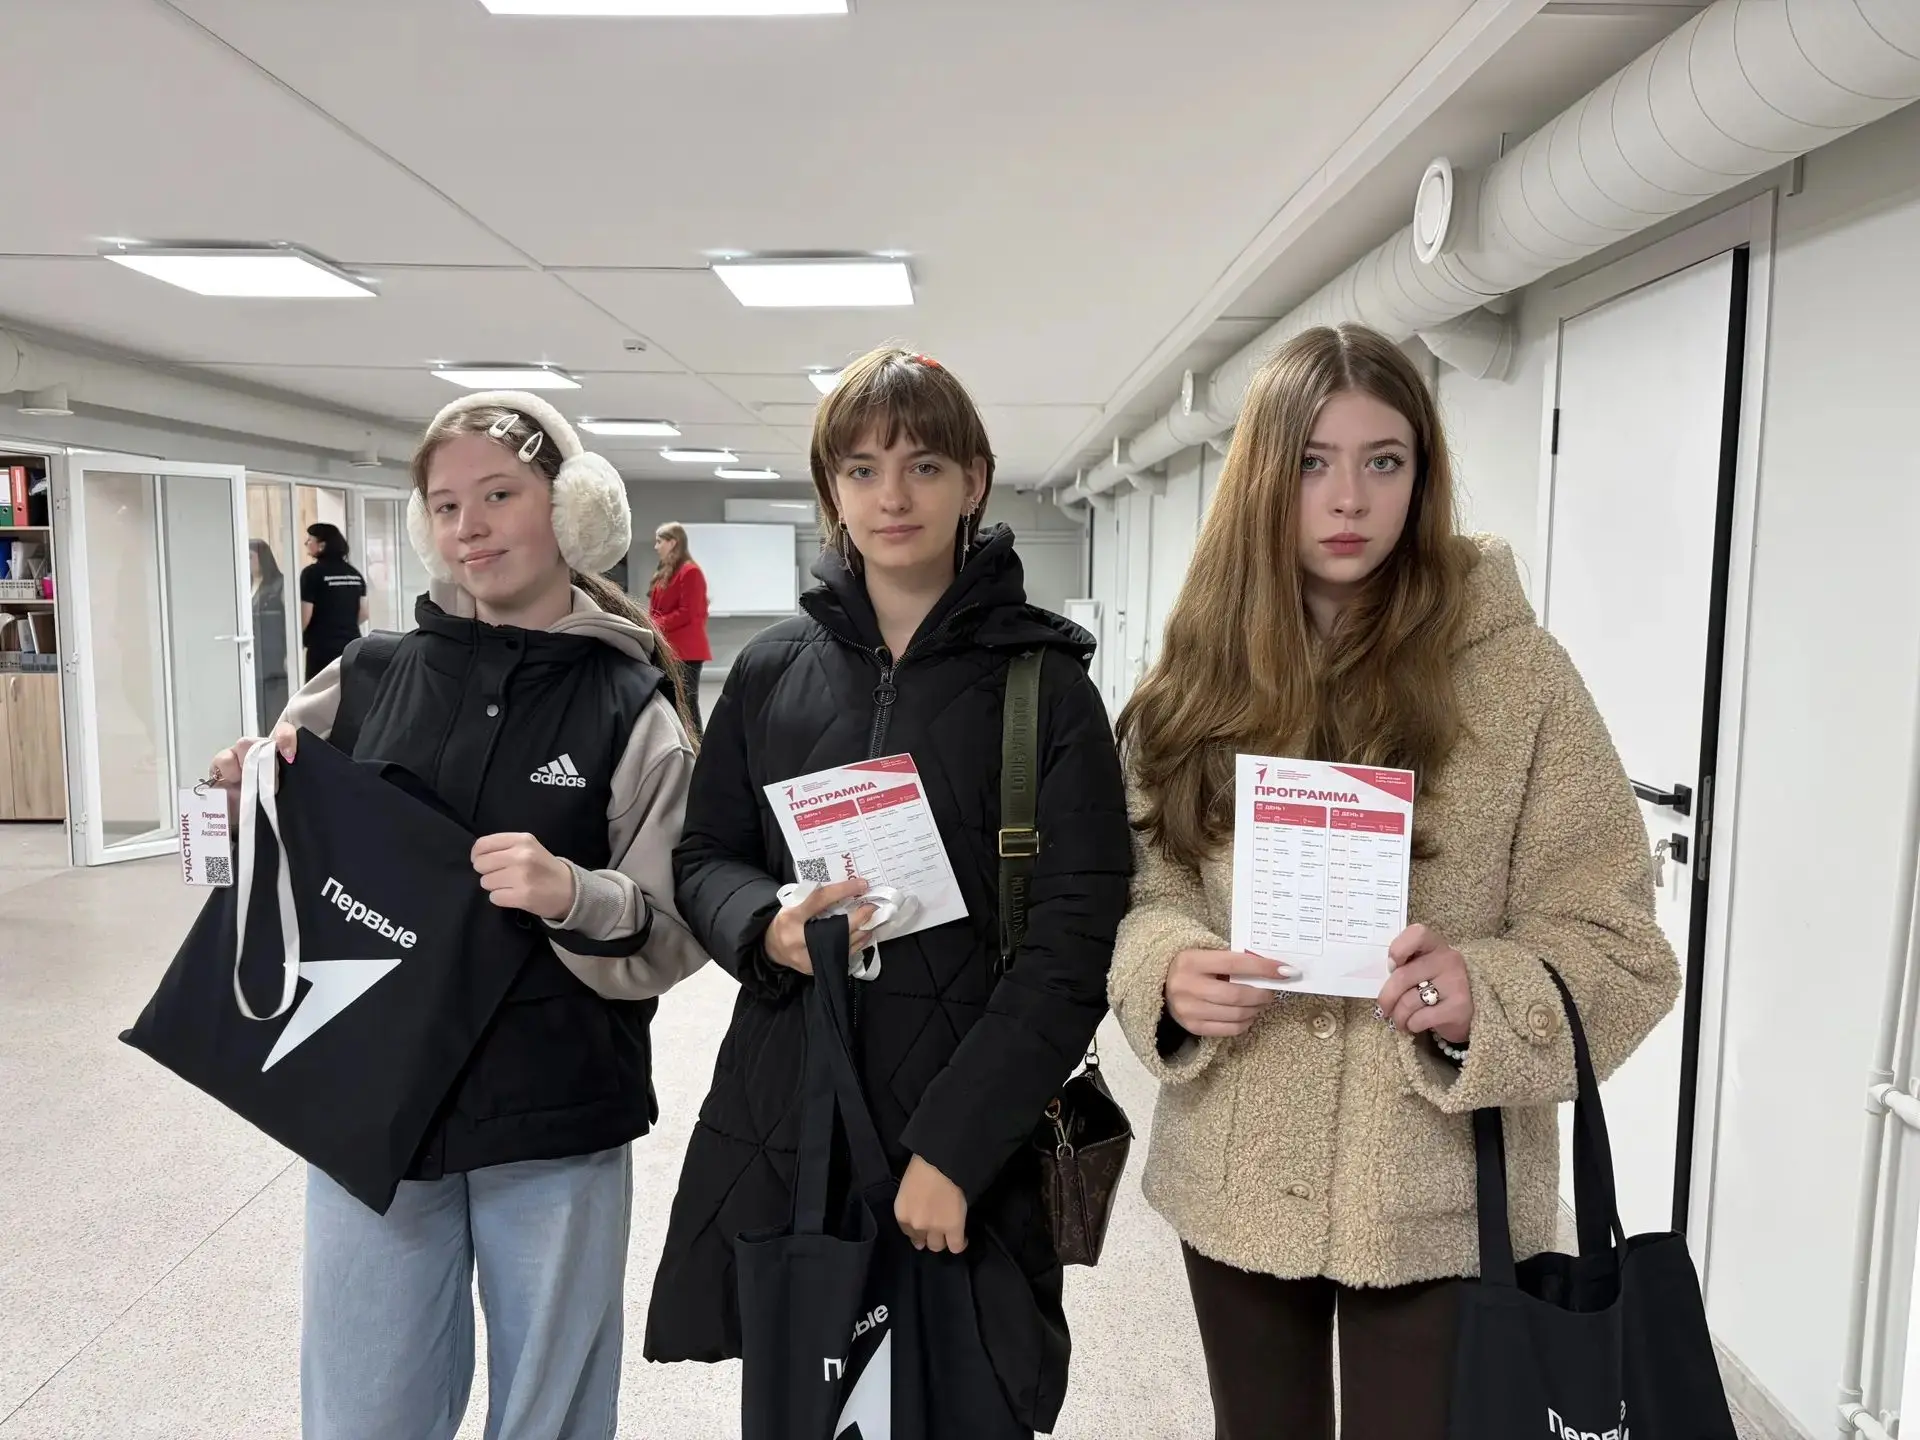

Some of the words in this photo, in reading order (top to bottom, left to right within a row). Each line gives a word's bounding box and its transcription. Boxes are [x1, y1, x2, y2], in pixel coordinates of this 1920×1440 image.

[530, 772, 587, 788] adidas
[1255, 785, 1360, 803] ПРОГРАММА
[789, 781, 877, 811] ПРОГРАММА
[202, 811, 225, 820] Первые
[181, 813, 194, 883] УЧАСТНИК
[320, 876, 418, 949] Первые
[823, 1304, 889, 1382] Пые
